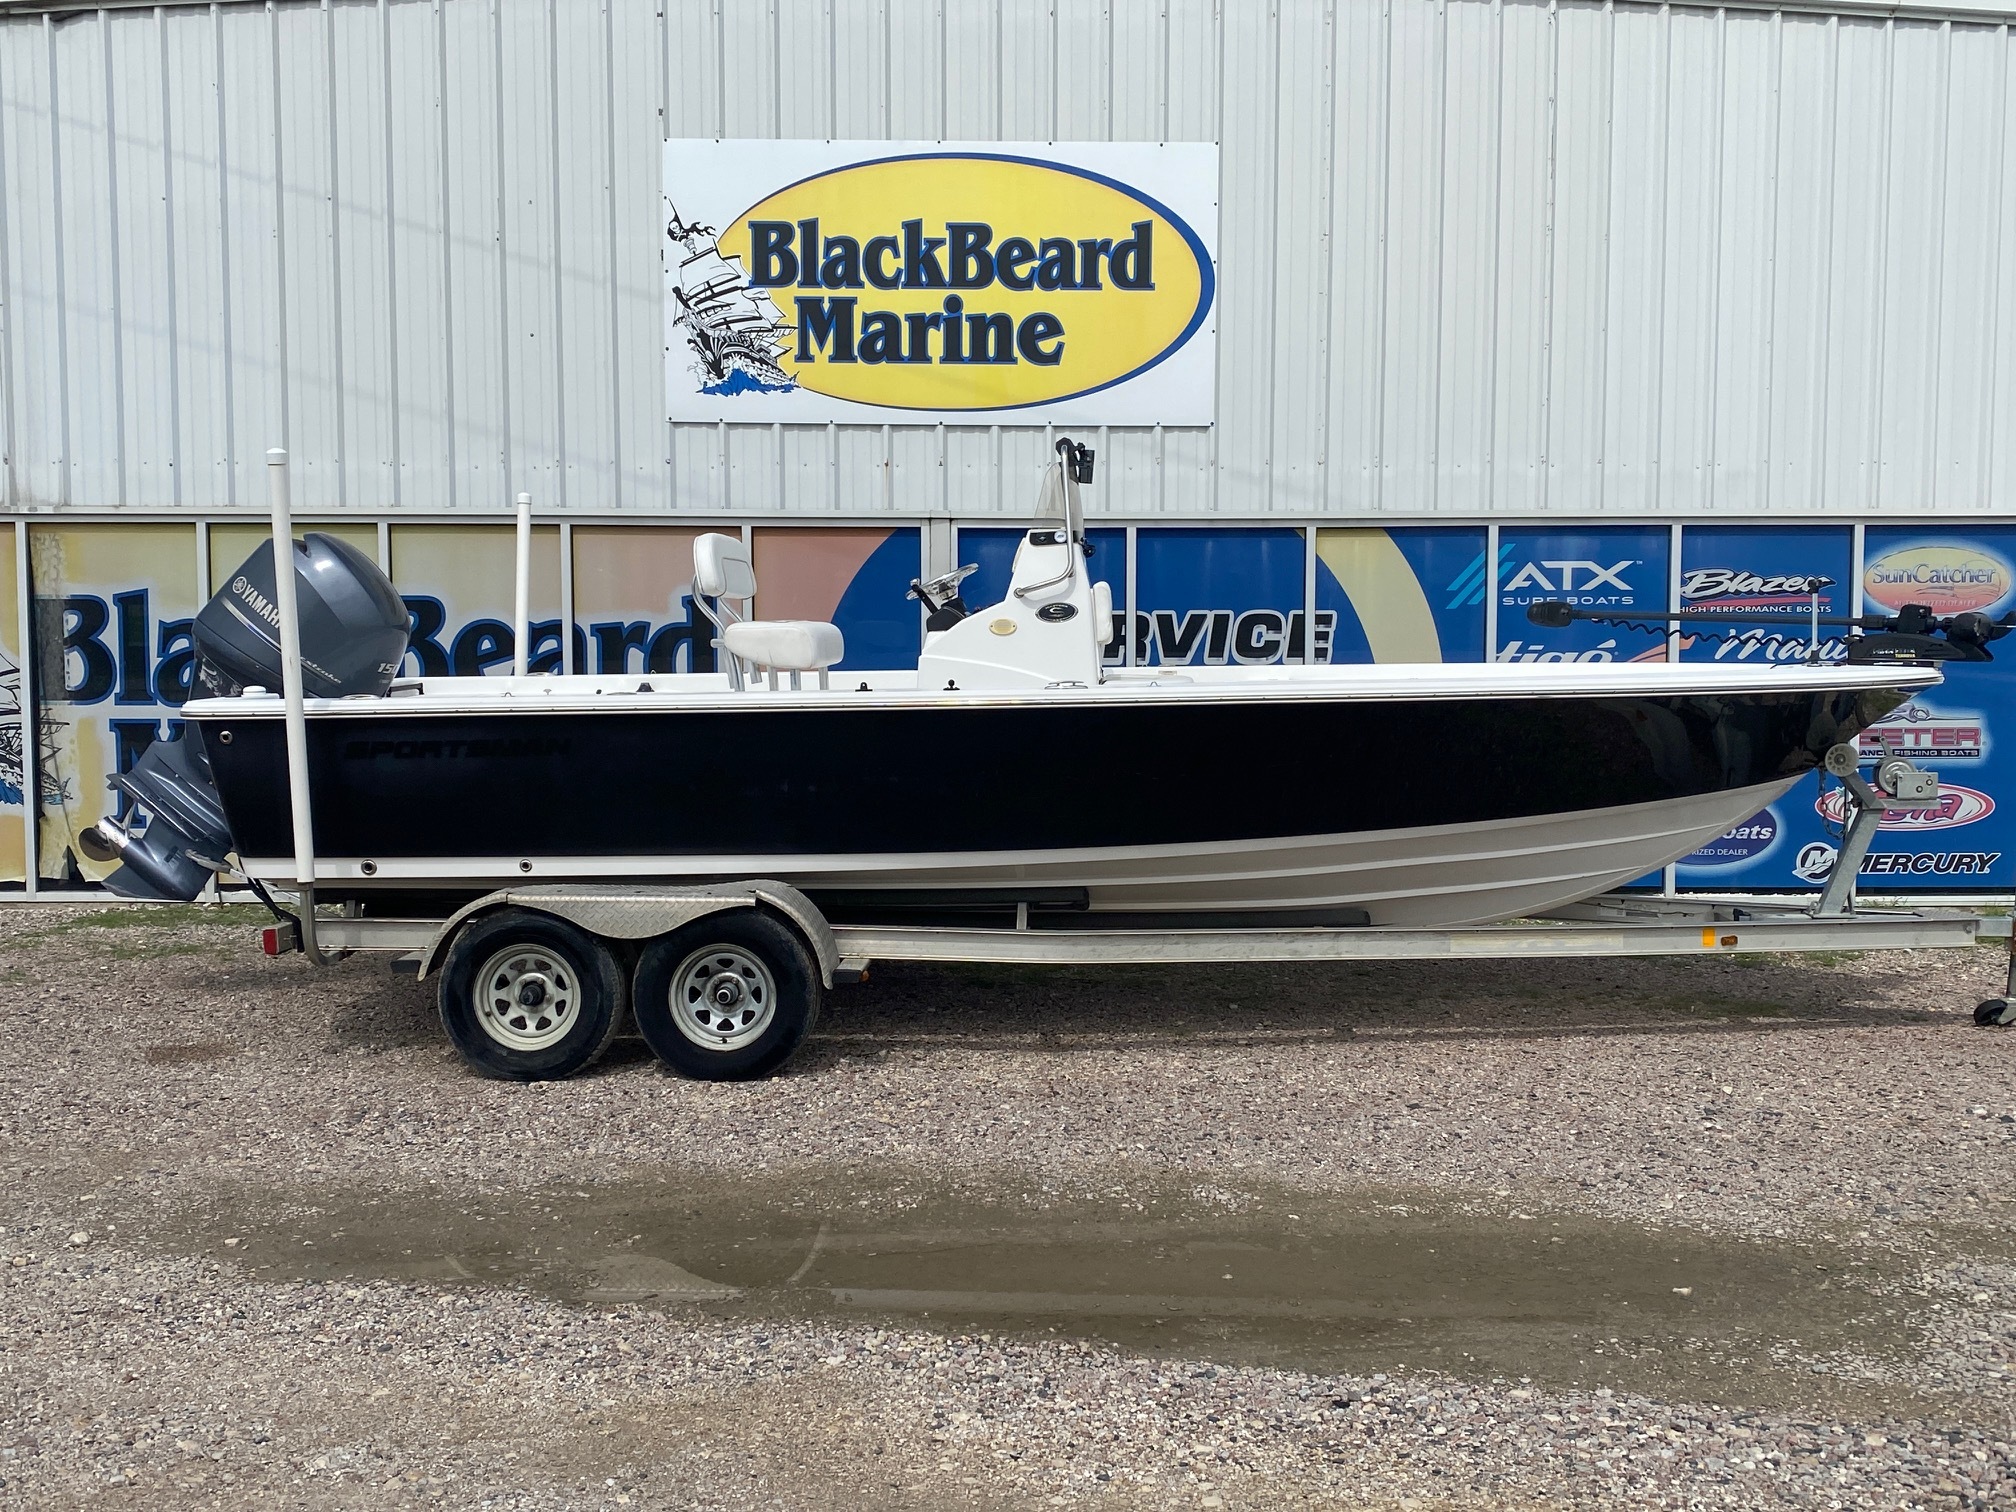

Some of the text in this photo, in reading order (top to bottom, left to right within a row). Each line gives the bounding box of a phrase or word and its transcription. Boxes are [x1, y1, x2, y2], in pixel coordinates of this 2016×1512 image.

[748, 217, 1155, 291] BlackBeard
[794, 294, 1065, 366] Marine
[1503, 560, 1634, 591] ATX
[1680, 567, 1836, 600] Blazer
[1872, 563, 1996, 584] SunCatcher
[1566, 596, 1634, 605] BOATS
[1680, 605, 1832, 614] HIGH PERFORMANCE BOATS
[1717, 848, 1748, 856] DEALER
